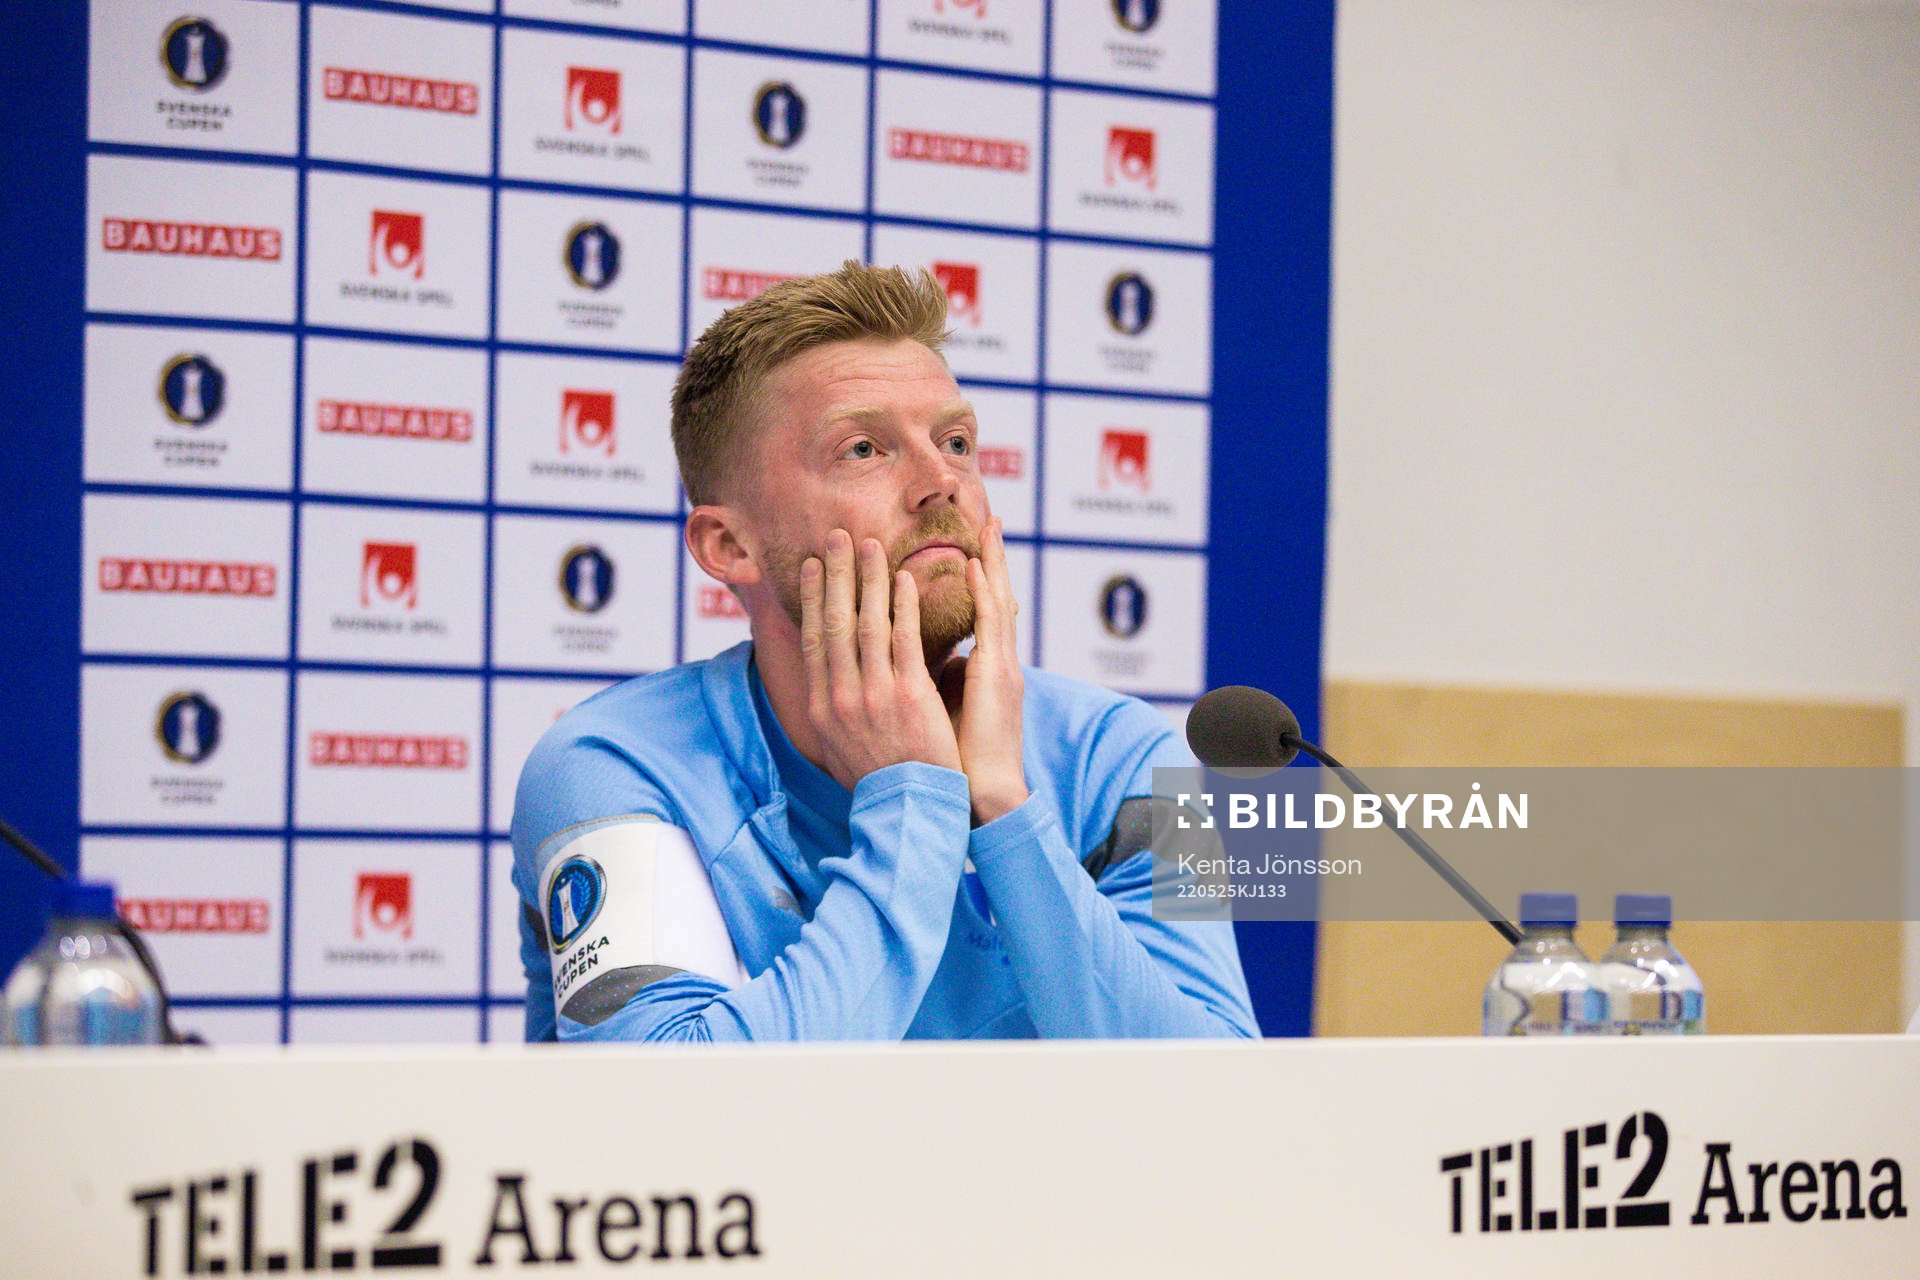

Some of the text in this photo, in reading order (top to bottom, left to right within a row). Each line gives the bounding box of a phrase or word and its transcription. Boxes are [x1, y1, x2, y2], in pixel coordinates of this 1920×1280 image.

[155, 99, 232, 117] SVENSKA
[324, 67, 478, 116] BAUHAUS
[166, 115, 223, 132] CUPEN
[103, 217, 282, 262] BAUHAUS
[317, 399, 473, 443] BAUHAUS
[100, 556, 277, 597] BAUHAUS
[309, 732, 468, 770] BAUHAUS
[117, 898, 268, 934] AUHAUS
[1440, 1111, 1909, 1234] TELE2 Arena
[130, 1138, 763, 1278] TELE2 Arena
